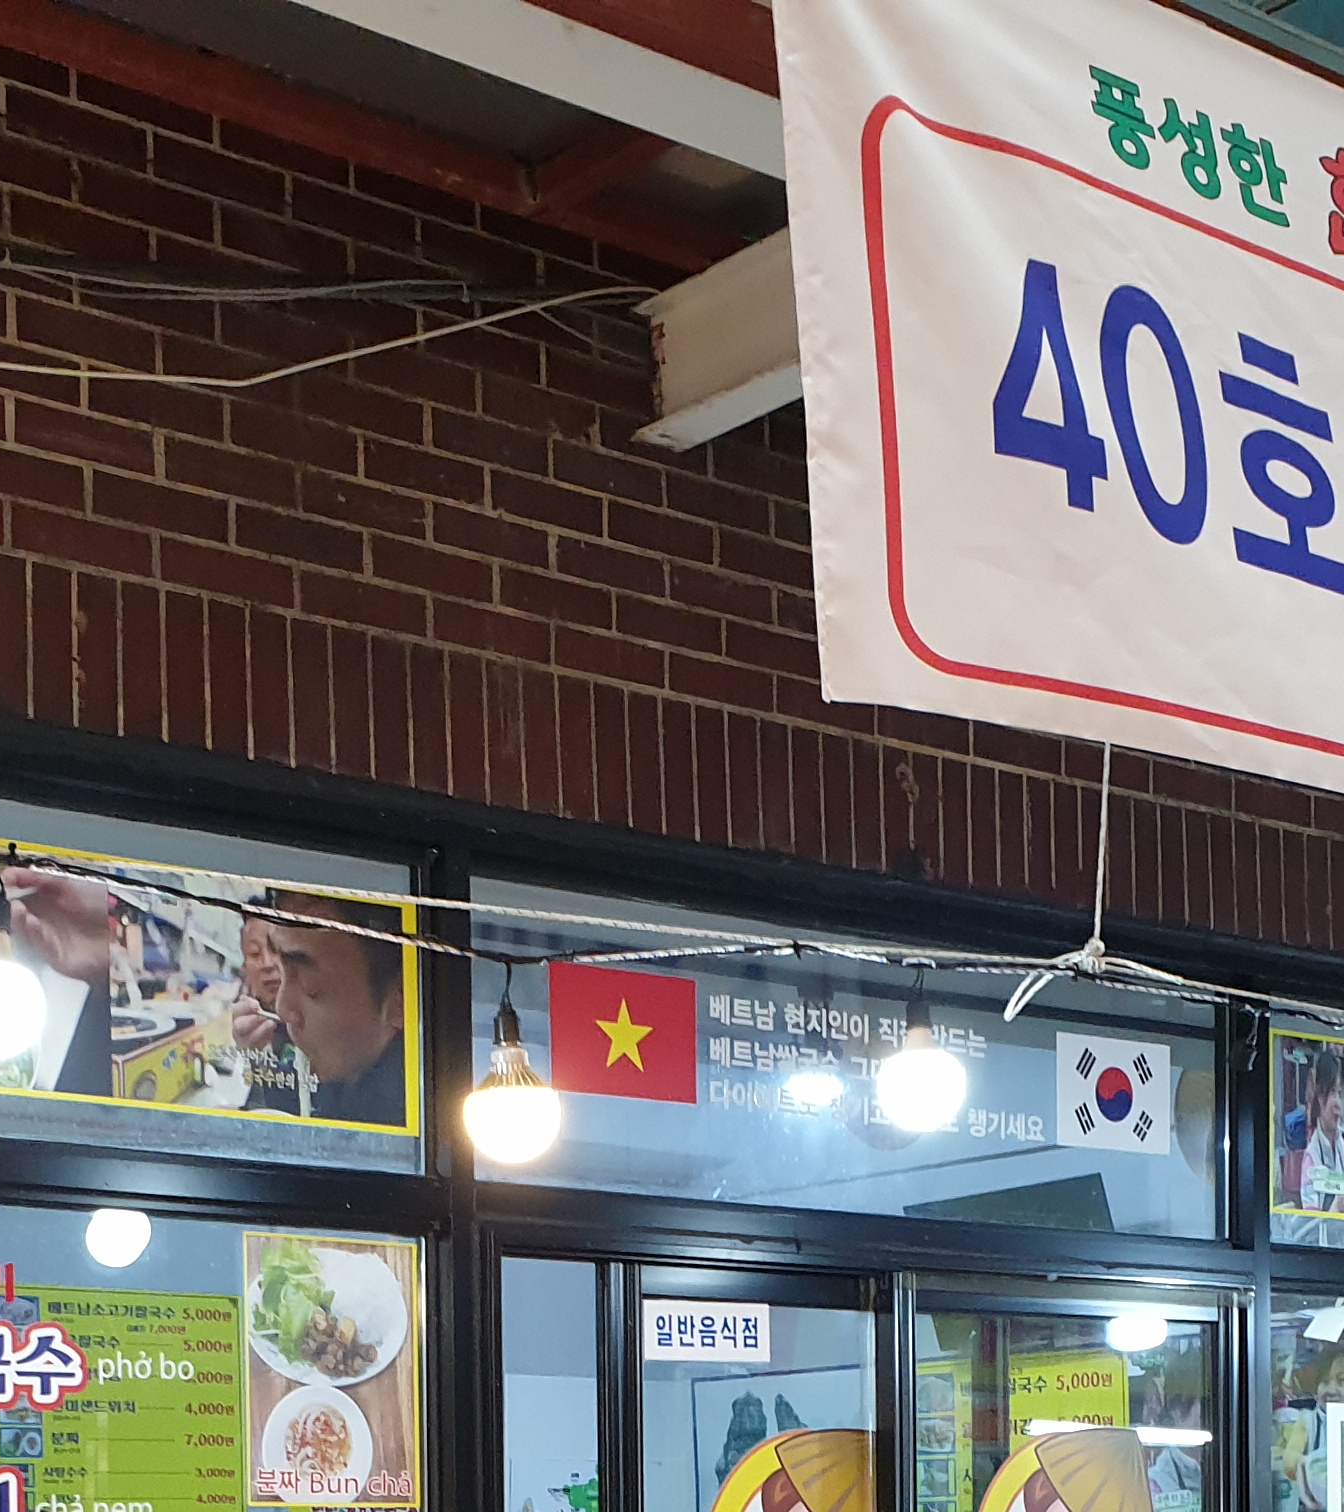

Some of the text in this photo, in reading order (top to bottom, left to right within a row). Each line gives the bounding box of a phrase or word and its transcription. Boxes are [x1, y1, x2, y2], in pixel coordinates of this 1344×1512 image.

[1088, 64, 1290, 229] 풍성한
[709, 994, 776, 1032] 베트남
[783, 1002, 870, 1045] 현지인이
[654, 1313, 761, 1351] 일반음식점
[1056, 1372, 1113, 1393] 5,000원
[310, 1471, 359, 1494] Bun
